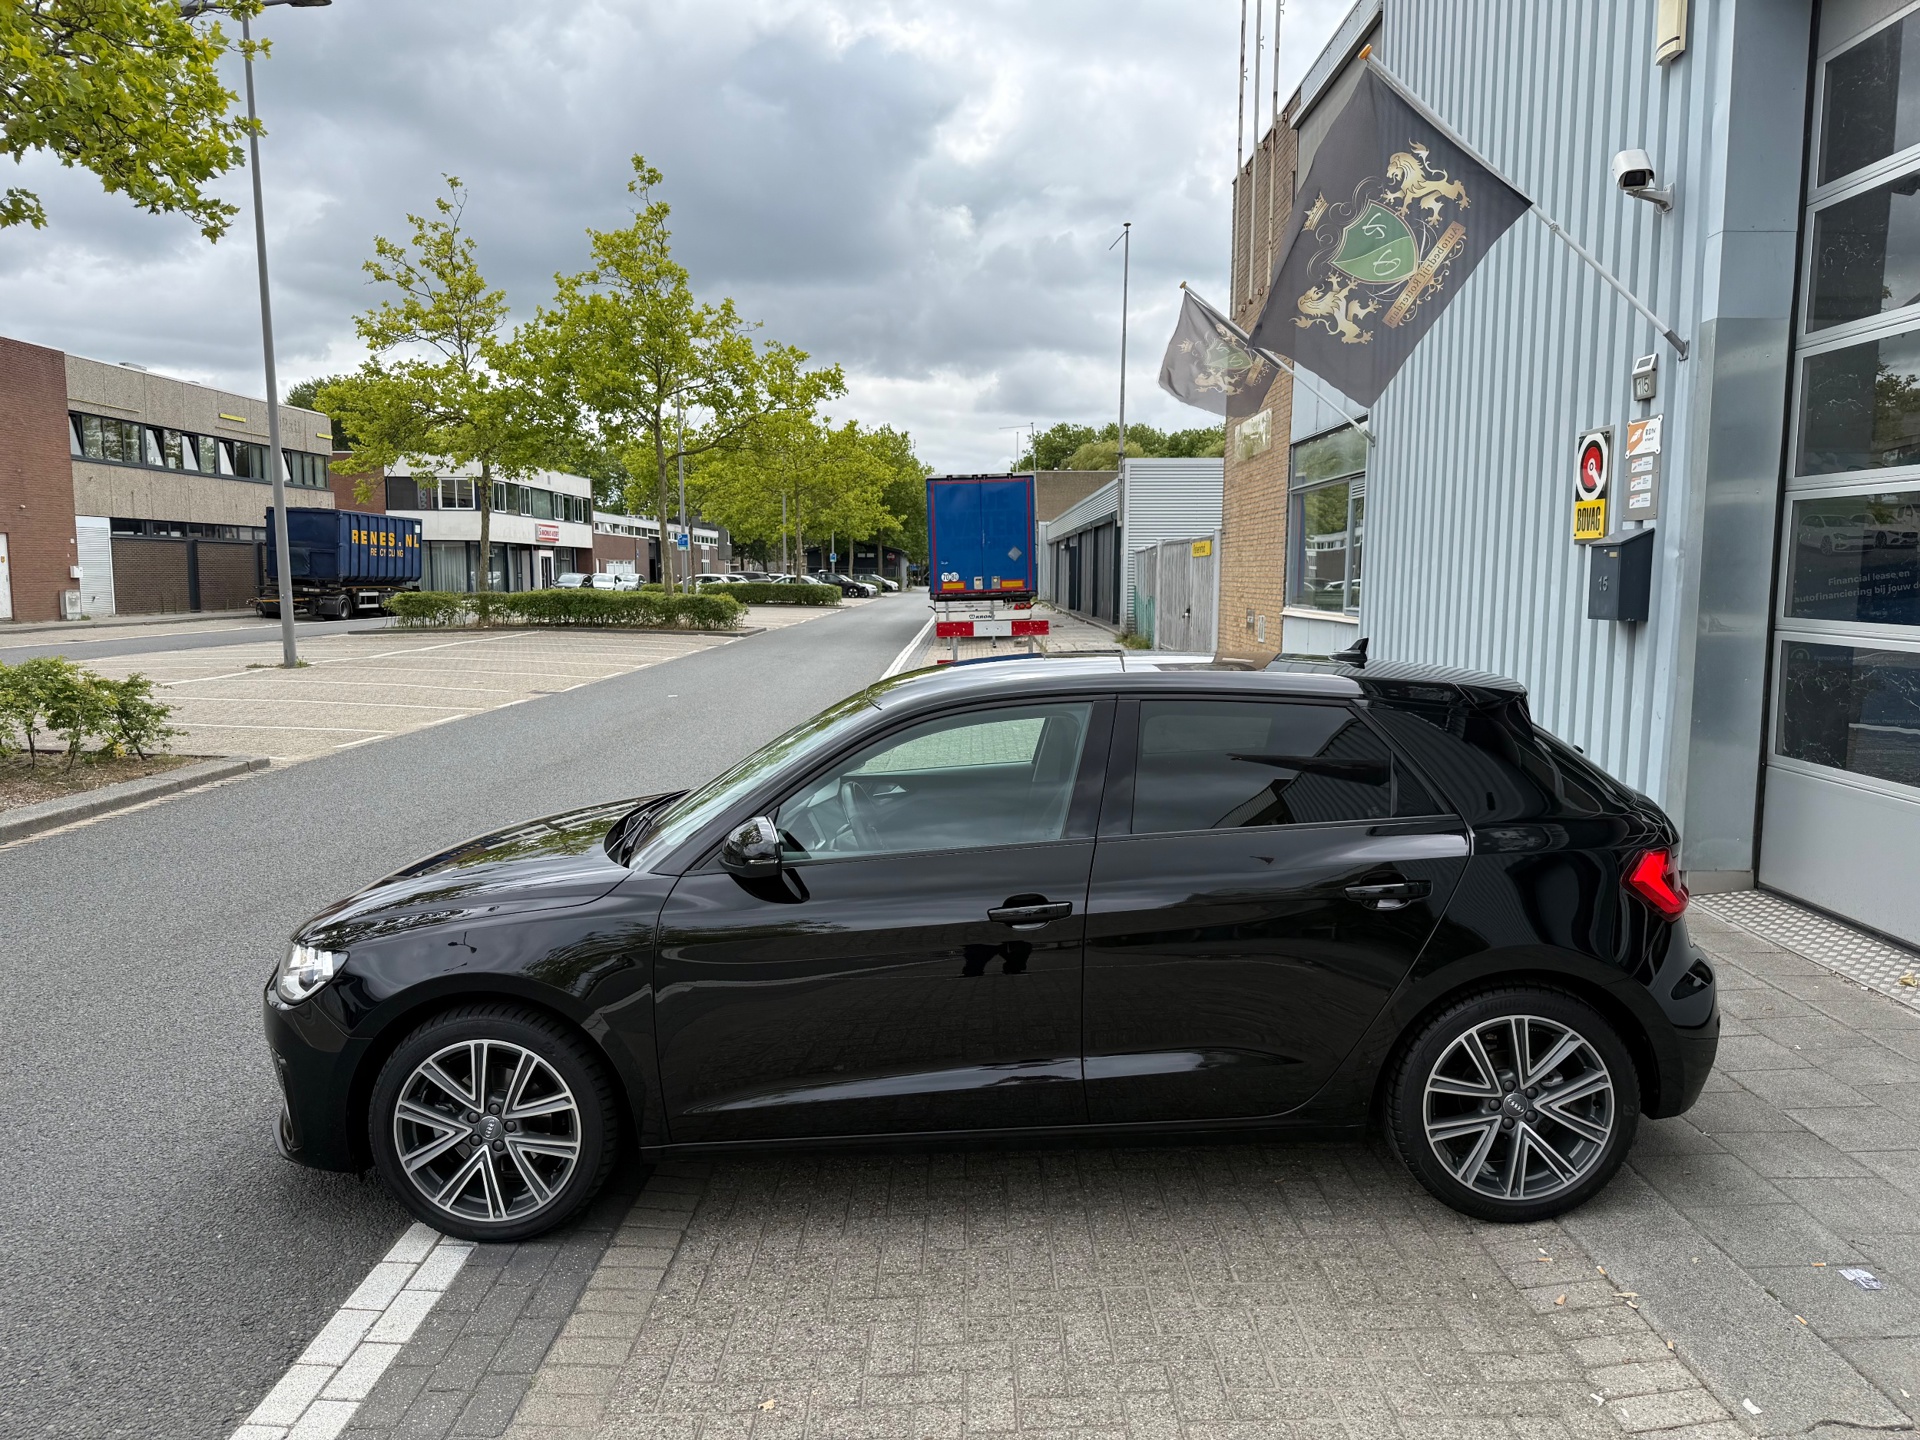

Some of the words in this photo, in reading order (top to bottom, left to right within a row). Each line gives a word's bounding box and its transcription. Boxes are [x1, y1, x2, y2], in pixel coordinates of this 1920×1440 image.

[1636, 376, 1650, 394] 15
[1576, 505, 1601, 532] BOVAG
[1598, 575, 1609, 592] 15
[1828, 574, 1871, 586] Financial
[1898, 570, 1910, 578] en
[1794, 587, 1872, 604] autofinanciering
[1874, 585, 1886, 595] bij
[1887, 583, 1911, 595] jouw
